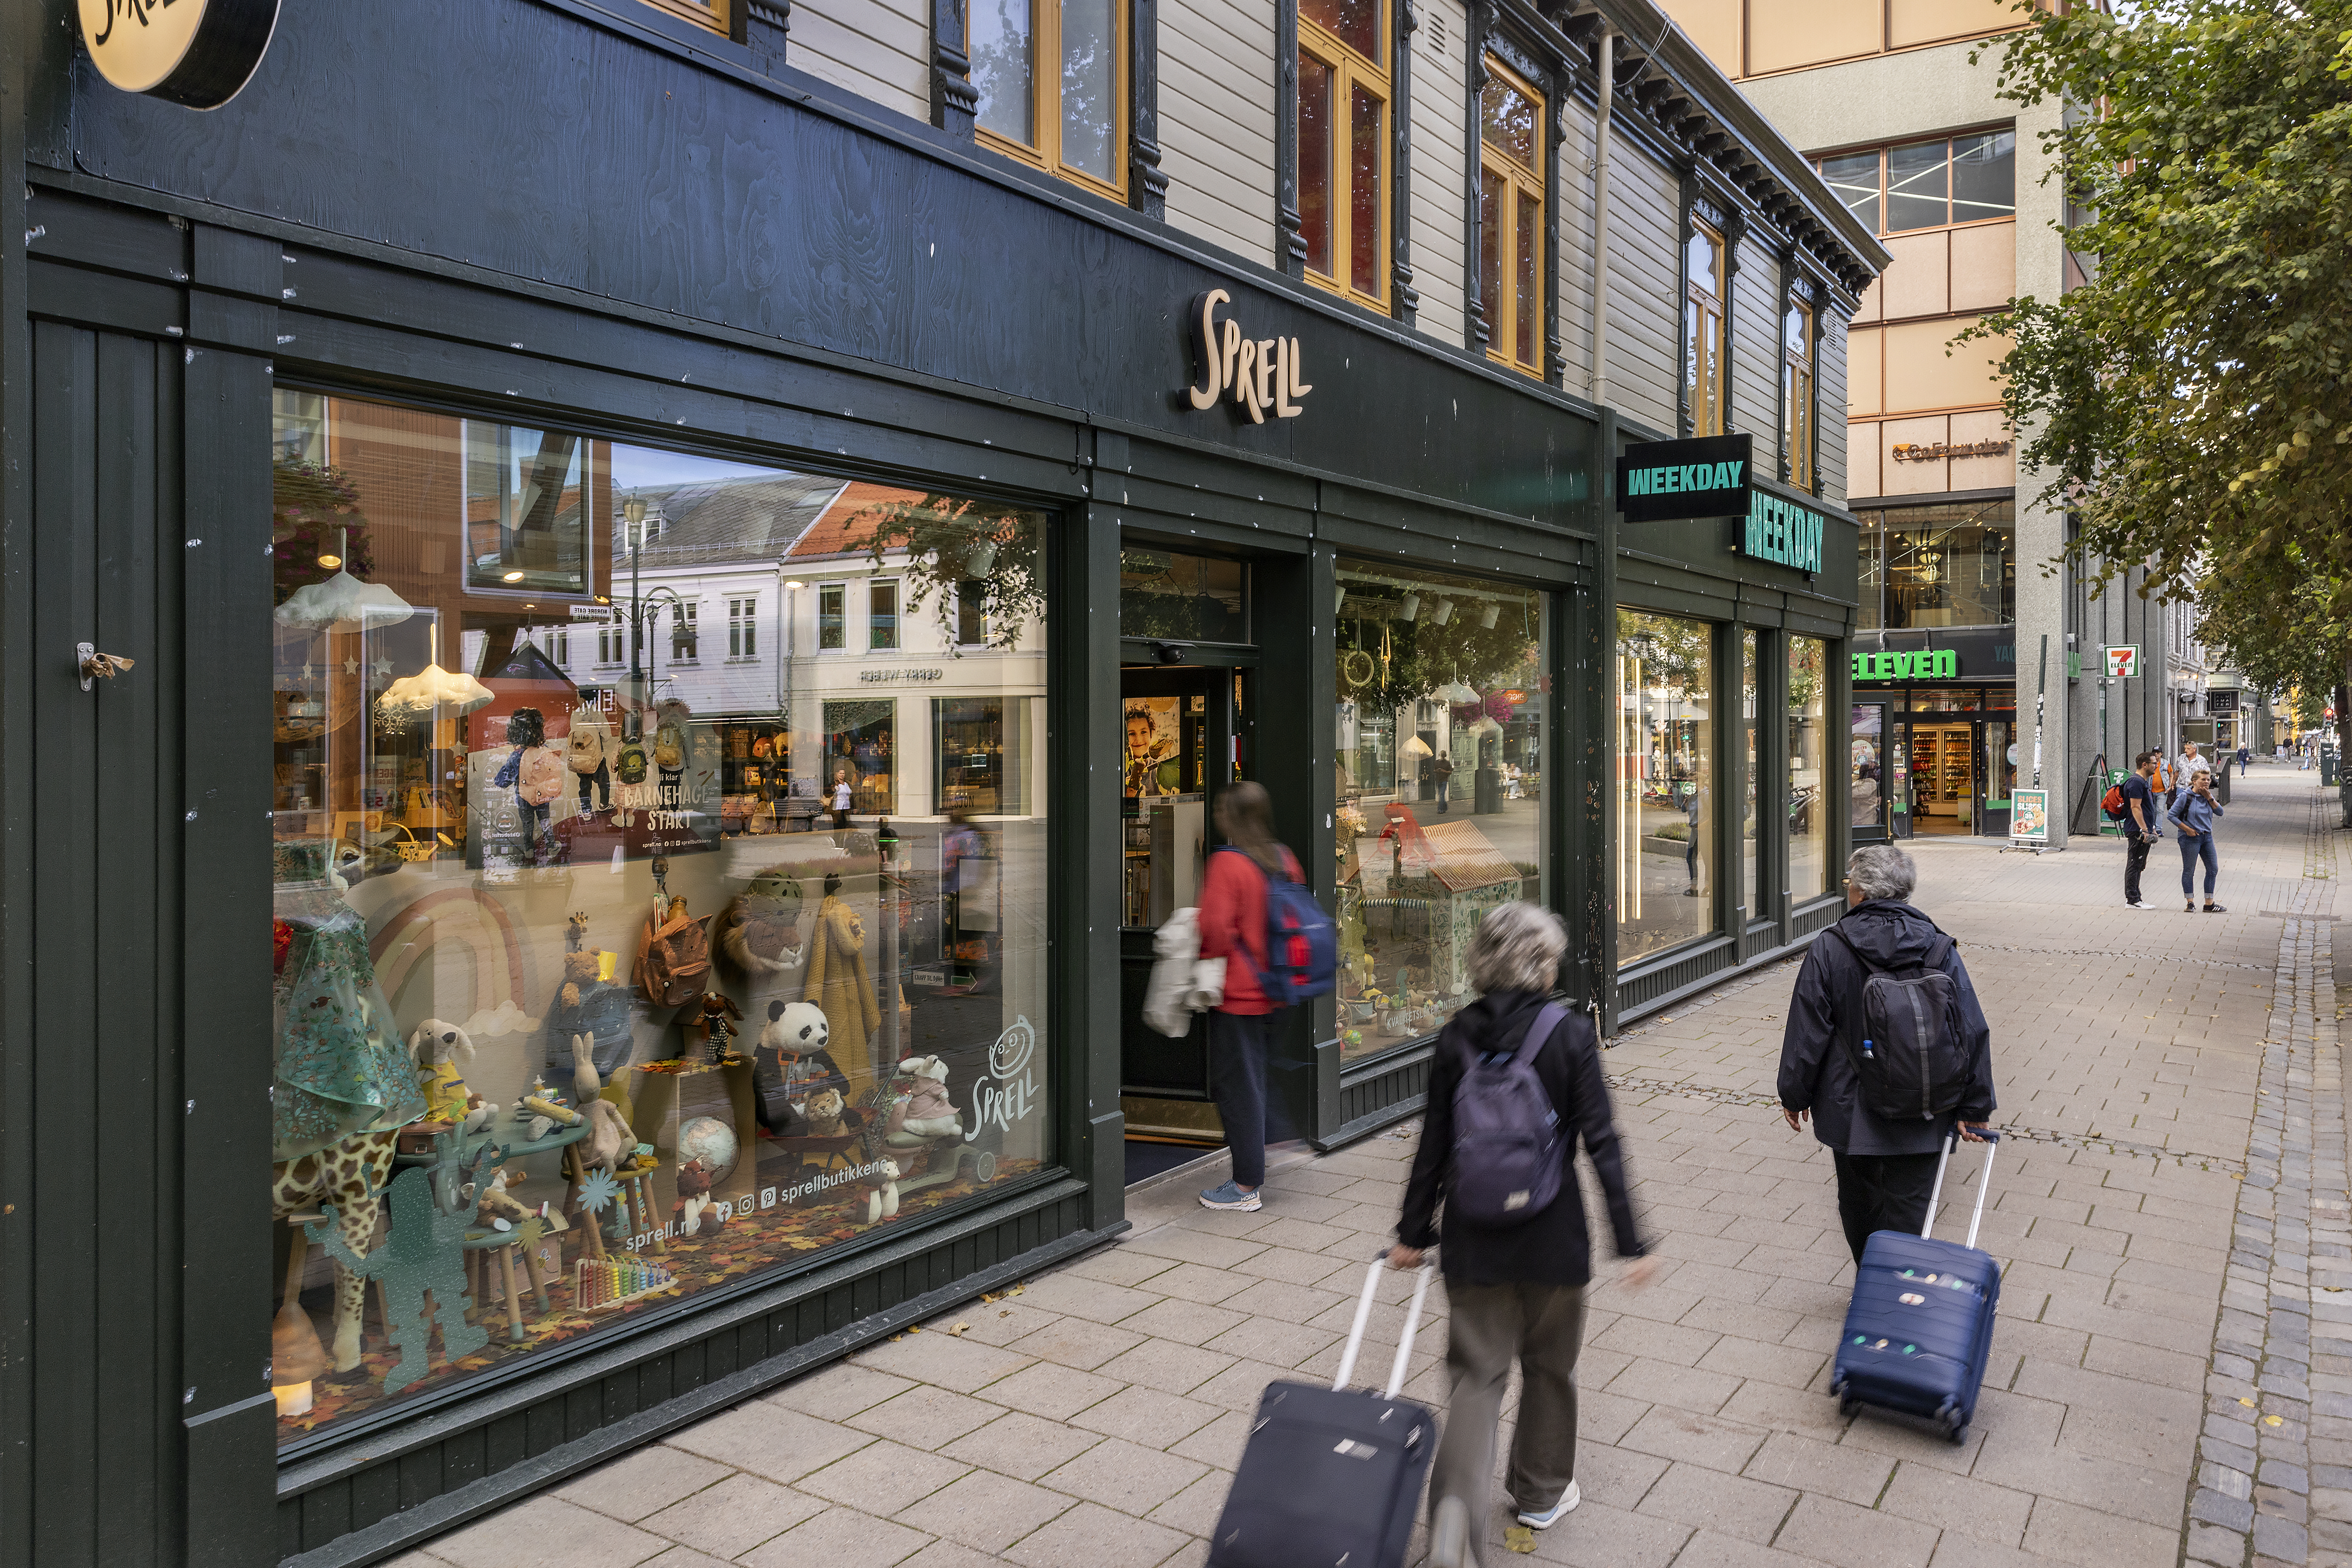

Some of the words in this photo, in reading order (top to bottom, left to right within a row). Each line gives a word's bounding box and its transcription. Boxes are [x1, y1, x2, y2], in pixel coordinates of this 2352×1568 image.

[1191, 288, 1313, 424] SPRELL
[1907, 438, 2009, 459] CoFounder
[1628, 461, 1743, 496] WEEKDAY
[1745, 490, 1823, 574] WEEKDAY
[1852, 649, 1957, 680] LEVEn
[2111, 650, 2132, 676] 7
[647, 809, 694, 831] START
[965, 1067, 1040, 1142] SPRELL
[626, 1216, 701, 1253] sprell.no
[781, 1158, 888, 1205] sprellbutikkene
